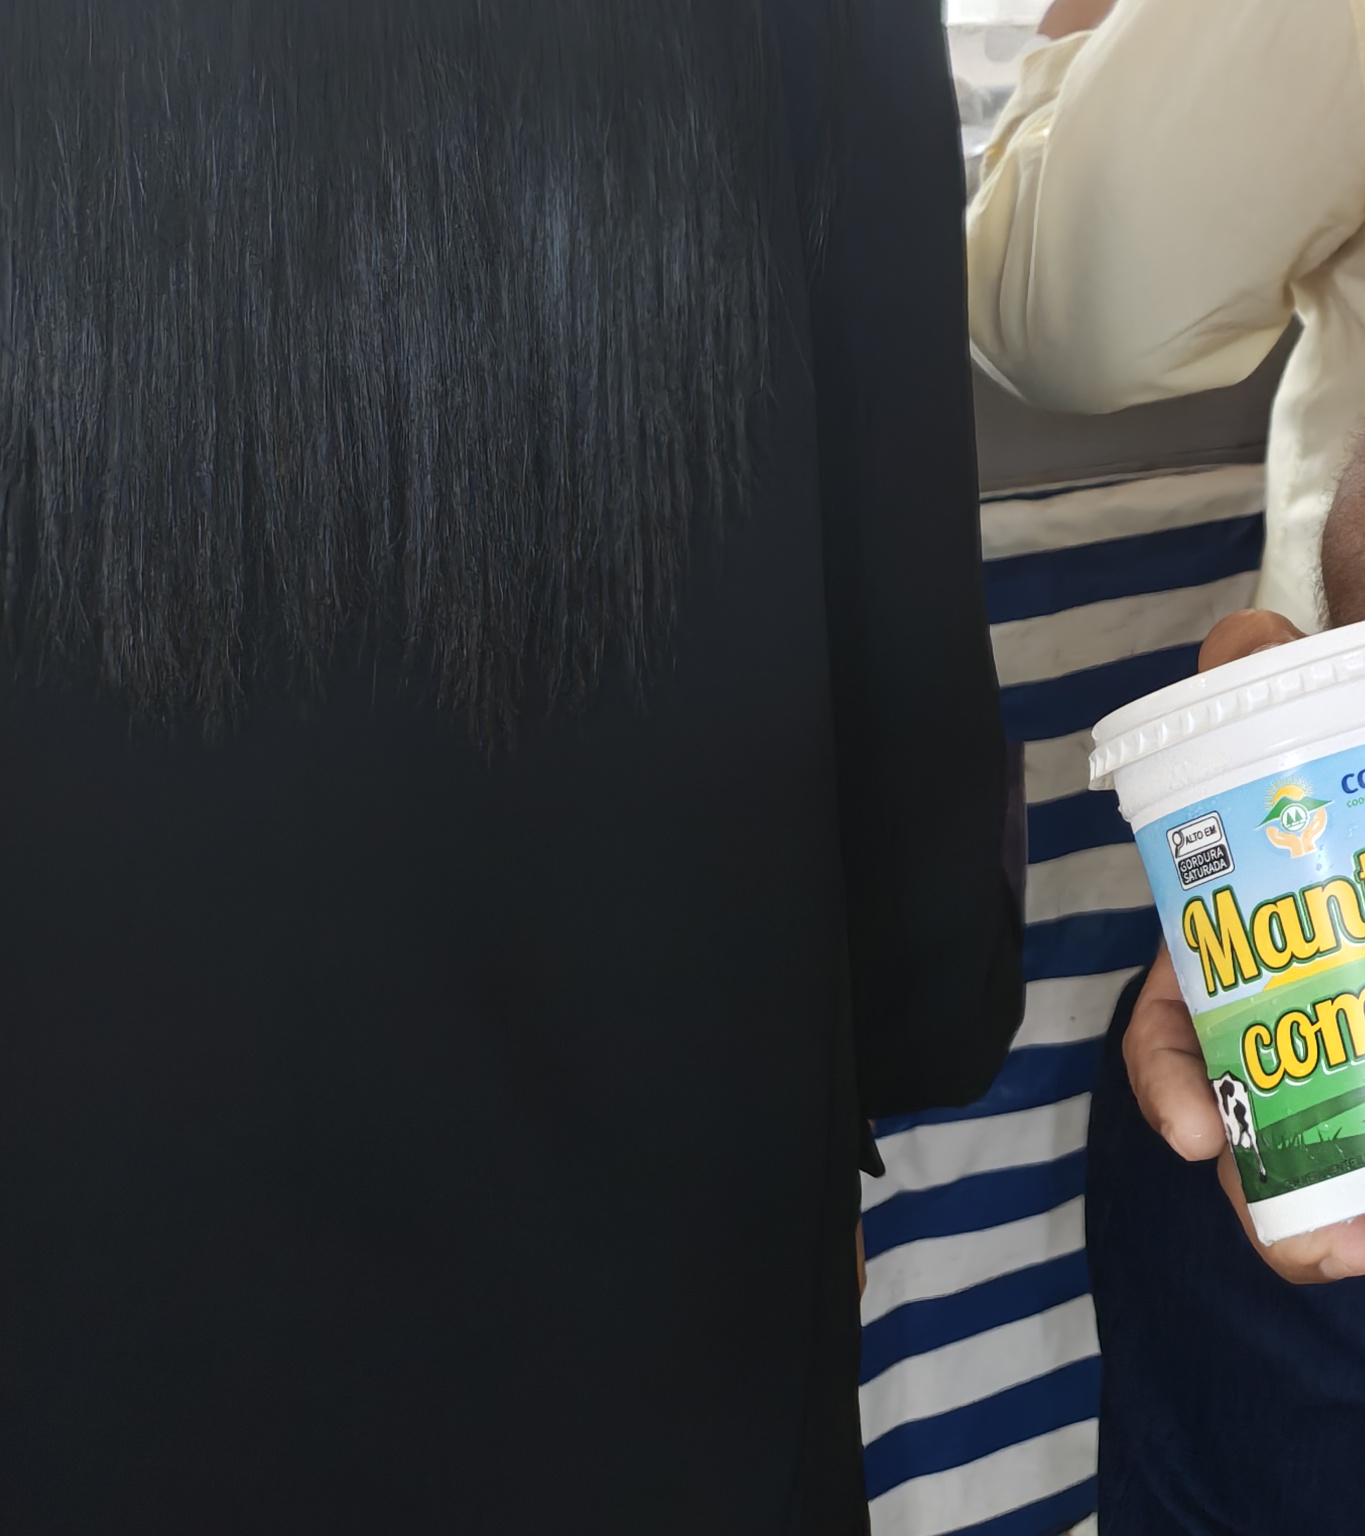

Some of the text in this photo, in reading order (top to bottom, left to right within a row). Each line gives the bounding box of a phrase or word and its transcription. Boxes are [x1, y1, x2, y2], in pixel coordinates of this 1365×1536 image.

[1185, 824, 1217, 845] ALTO EM
[1180, 847, 1224, 873] GORDURA
[1183, 859, 1228, 884] SATURADA
